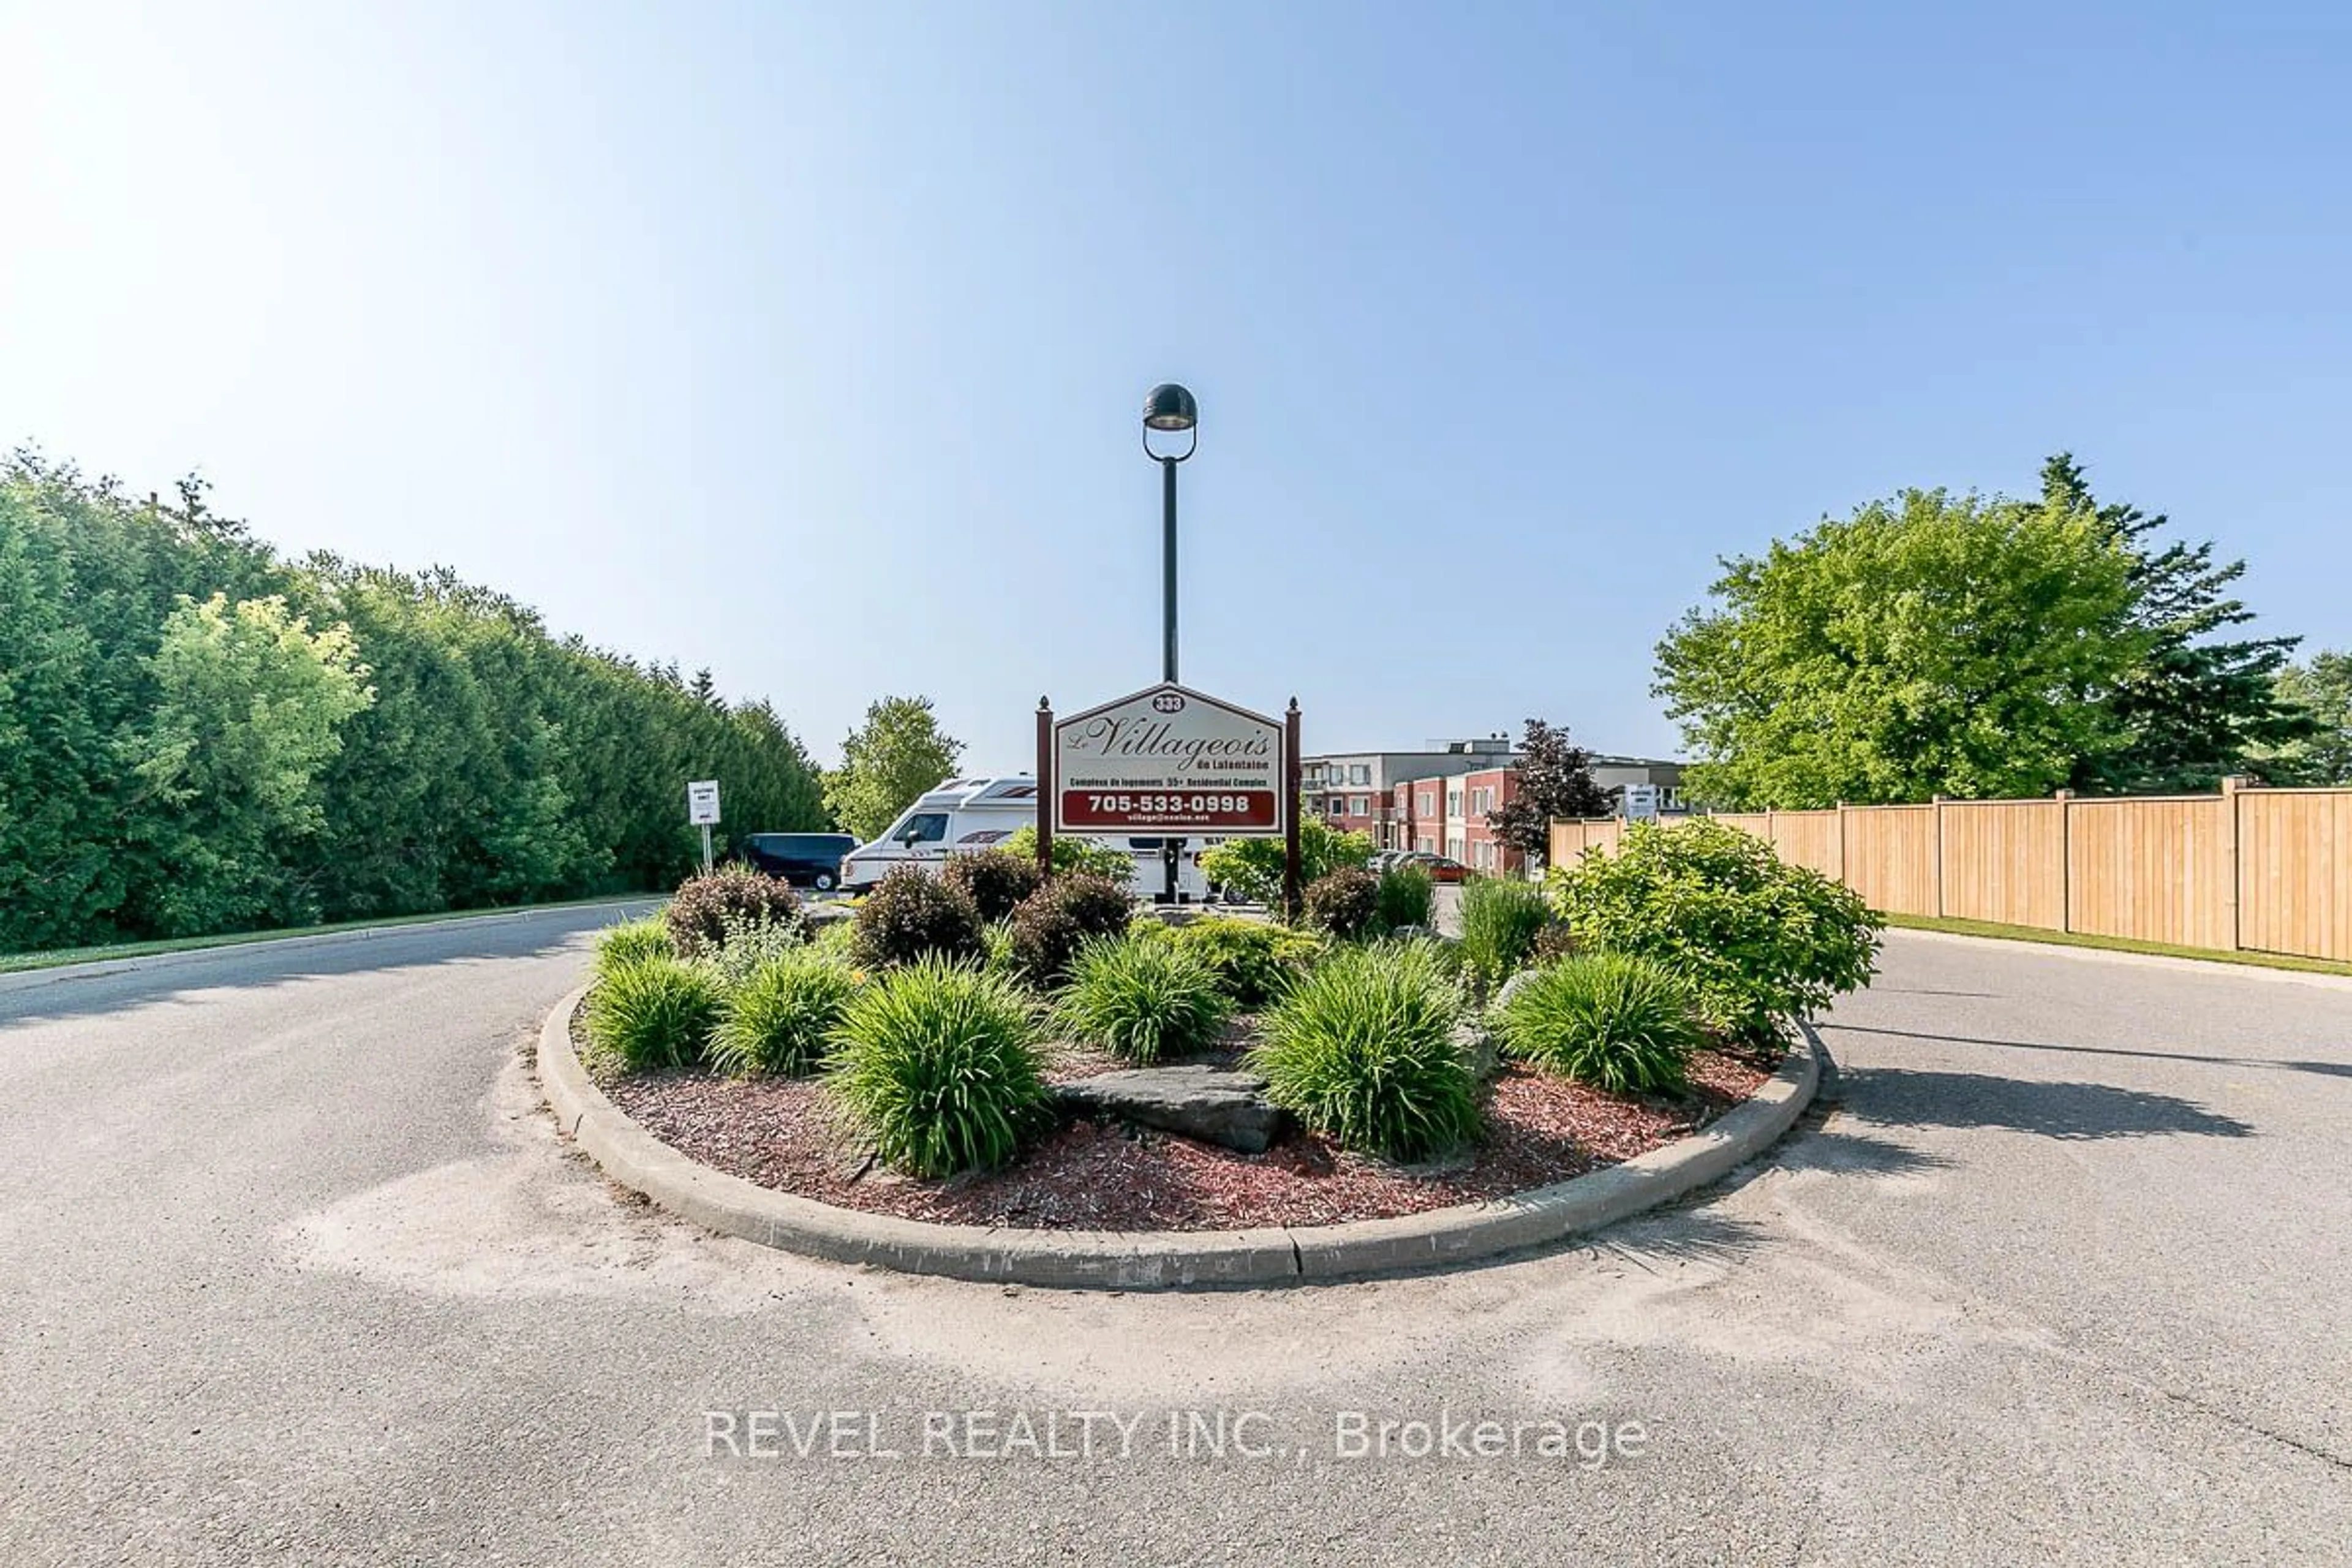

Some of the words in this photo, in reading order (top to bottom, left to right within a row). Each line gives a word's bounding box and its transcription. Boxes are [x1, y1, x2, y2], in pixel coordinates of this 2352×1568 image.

[1156, 697, 1182, 711] 333
[1086, 717, 1271, 771] Villageois
[1088, 796, 1249, 812] 705-533-0998
